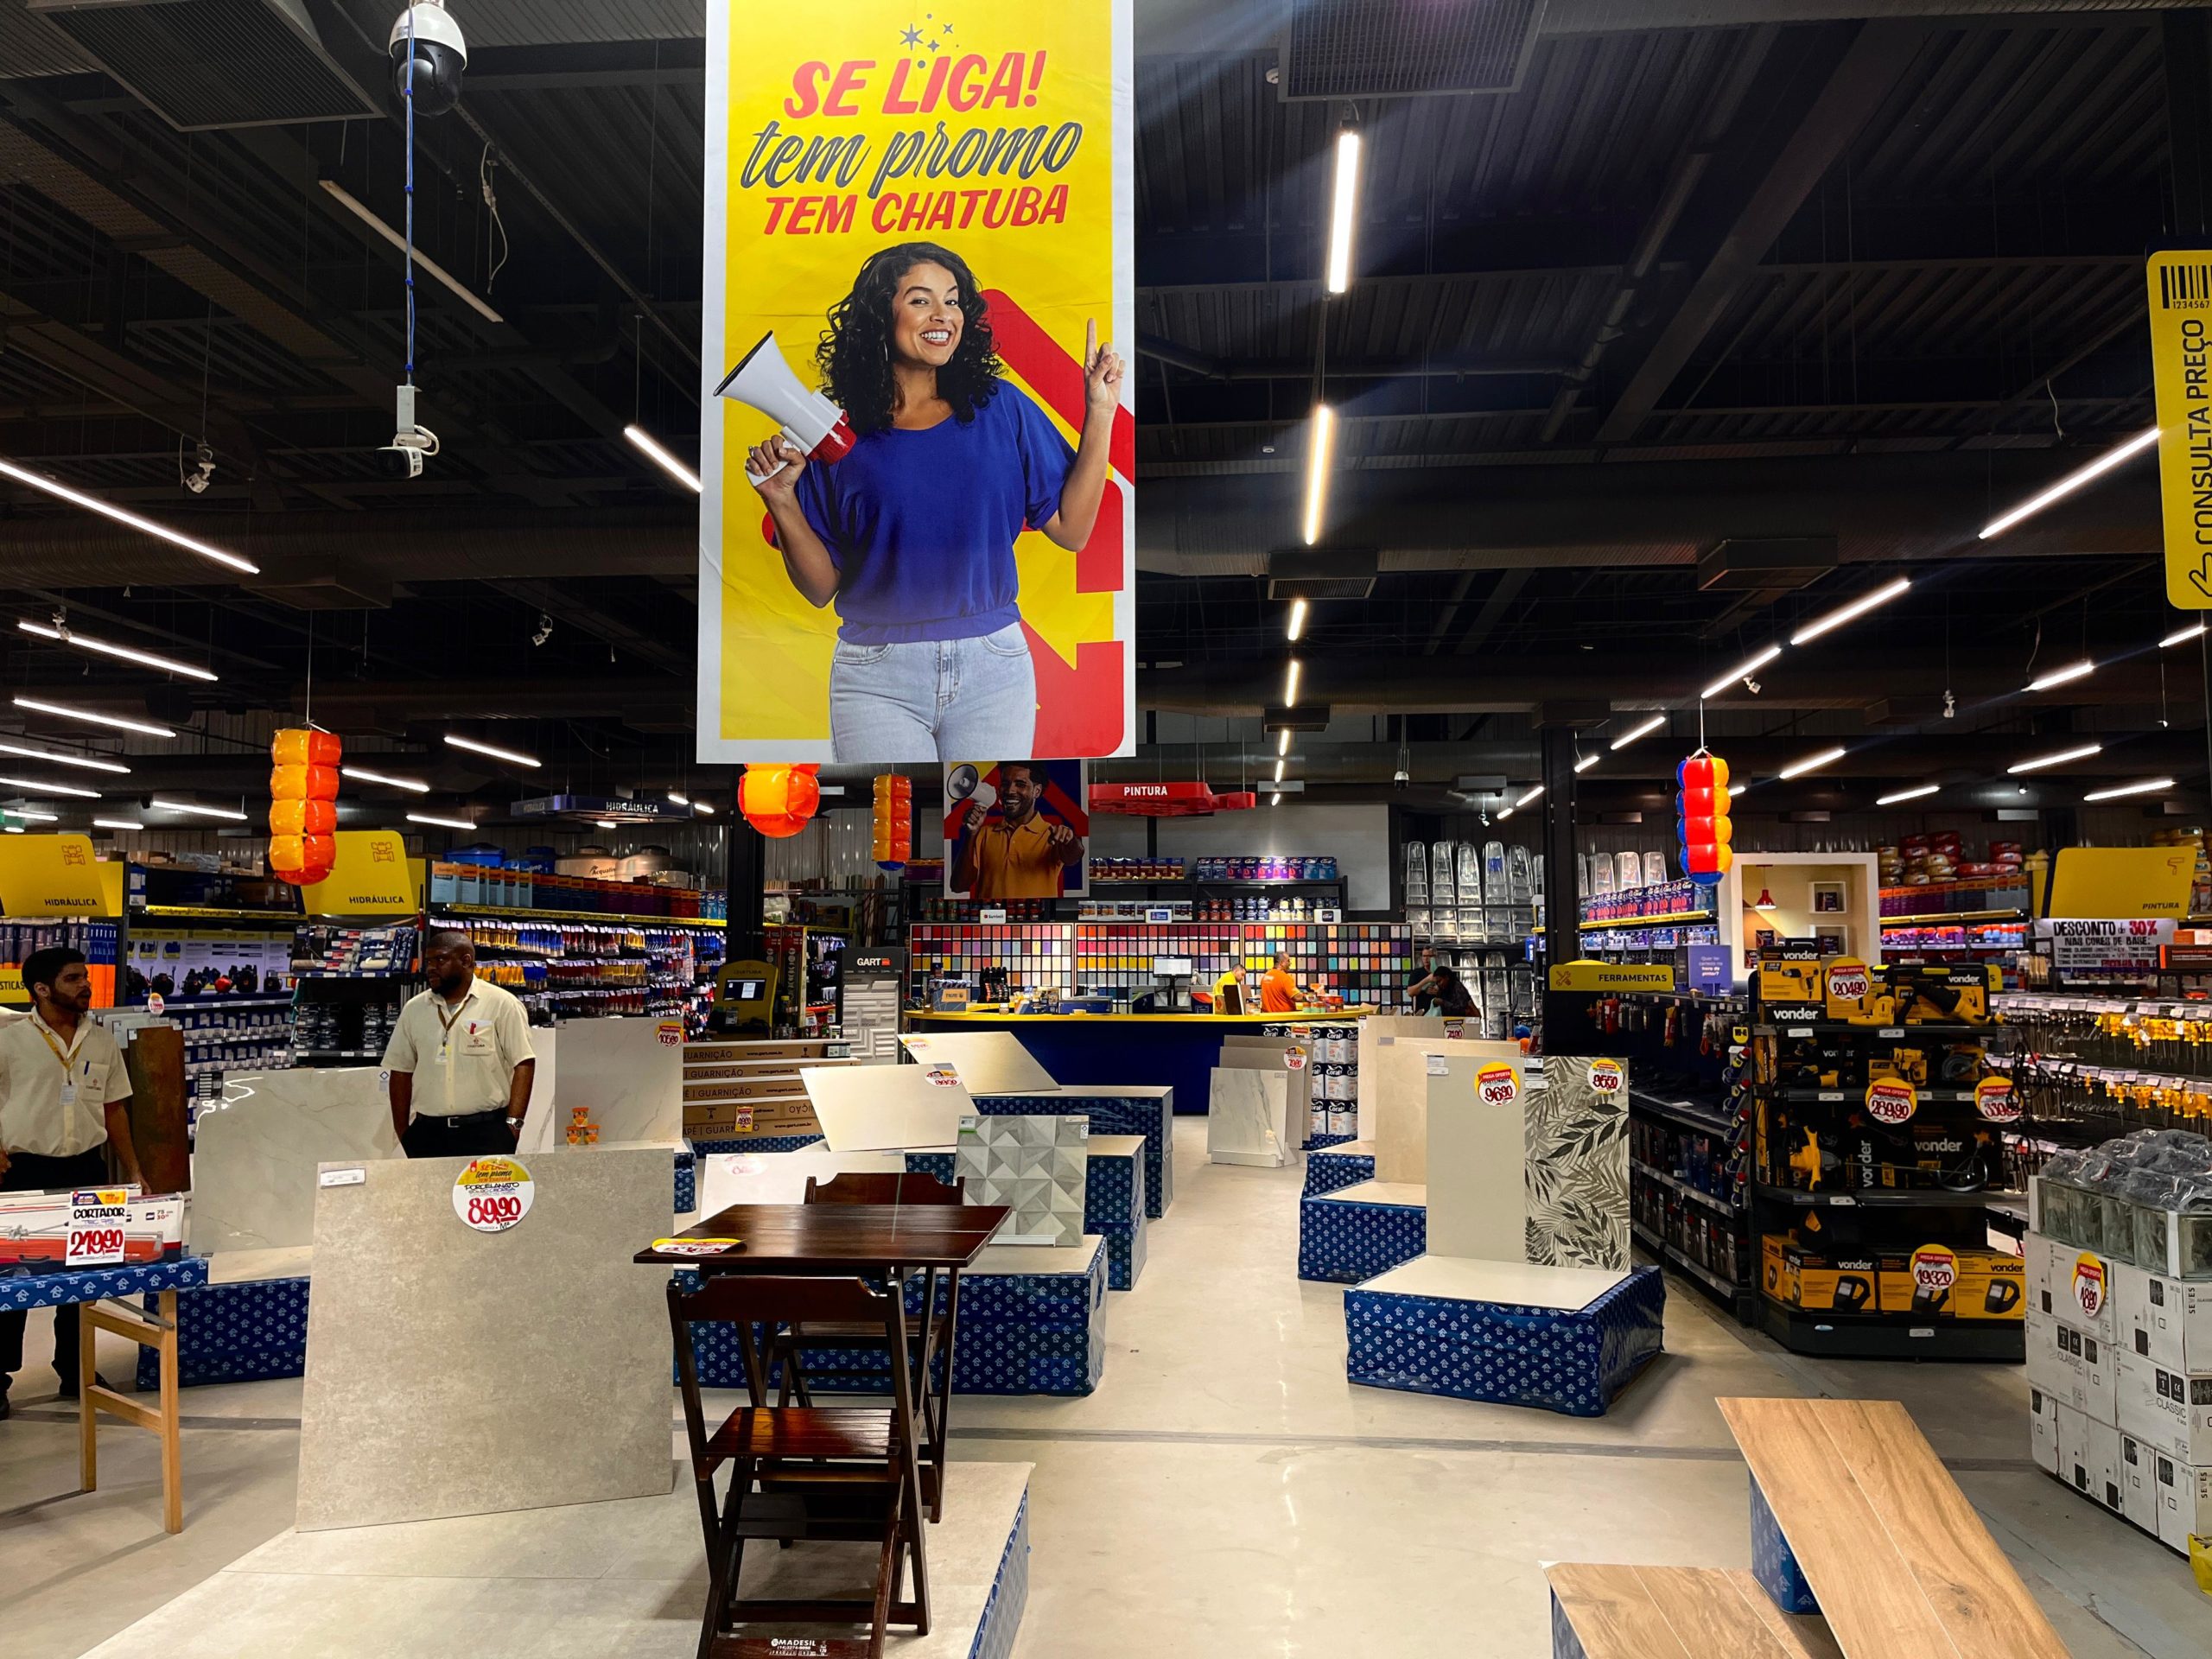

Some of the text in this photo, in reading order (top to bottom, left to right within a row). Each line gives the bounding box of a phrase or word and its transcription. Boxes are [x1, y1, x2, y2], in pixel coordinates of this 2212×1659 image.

[784, 50, 1046, 118] SE LIGA!
[741, 120, 1083, 200] tem promo
[764, 184, 1069, 235] TEM CHATUBA
[2182, 320, 2212, 545] CONSULTA PREÇO
[1124, 785, 1167, 796] PINTURA
[606, 801, 658, 814] HIDRÁULICA
[45, 895, 97, 906] HIDRÁULICA
[349, 895, 404, 904] HIDRÁULICA
[2054, 921, 2116, 936] DESCONTO
[2129, 920, 2158, 936] 30%
[2086, 937, 2110, 946] CORES
[2113, 937, 2122, 946] DE
[1783, 950, 1818, 960] vonder
[857, 957, 881, 966] GART
[1948, 975, 1980, 983] vonder
[1774, 1007, 1818, 1020] vonder
[691, 1069, 743, 1078] GUARNIÇÃO
[698, 1087, 752, 1098] GUARNIÇÃO
[1915, 1138, 1963, 1153] vonder
[464, 1182, 519, 1191] PORCELANATO
[73, 1207, 125, 1219] CORTADOR
[1839, 1260, 1872, 1269] vonder
[1991, 1263, 2024, 1272] vonder
[2057, 1351, 2082, 1370] CLASSIC
[2157, 1397, 2186, 1418] CLASSIC
